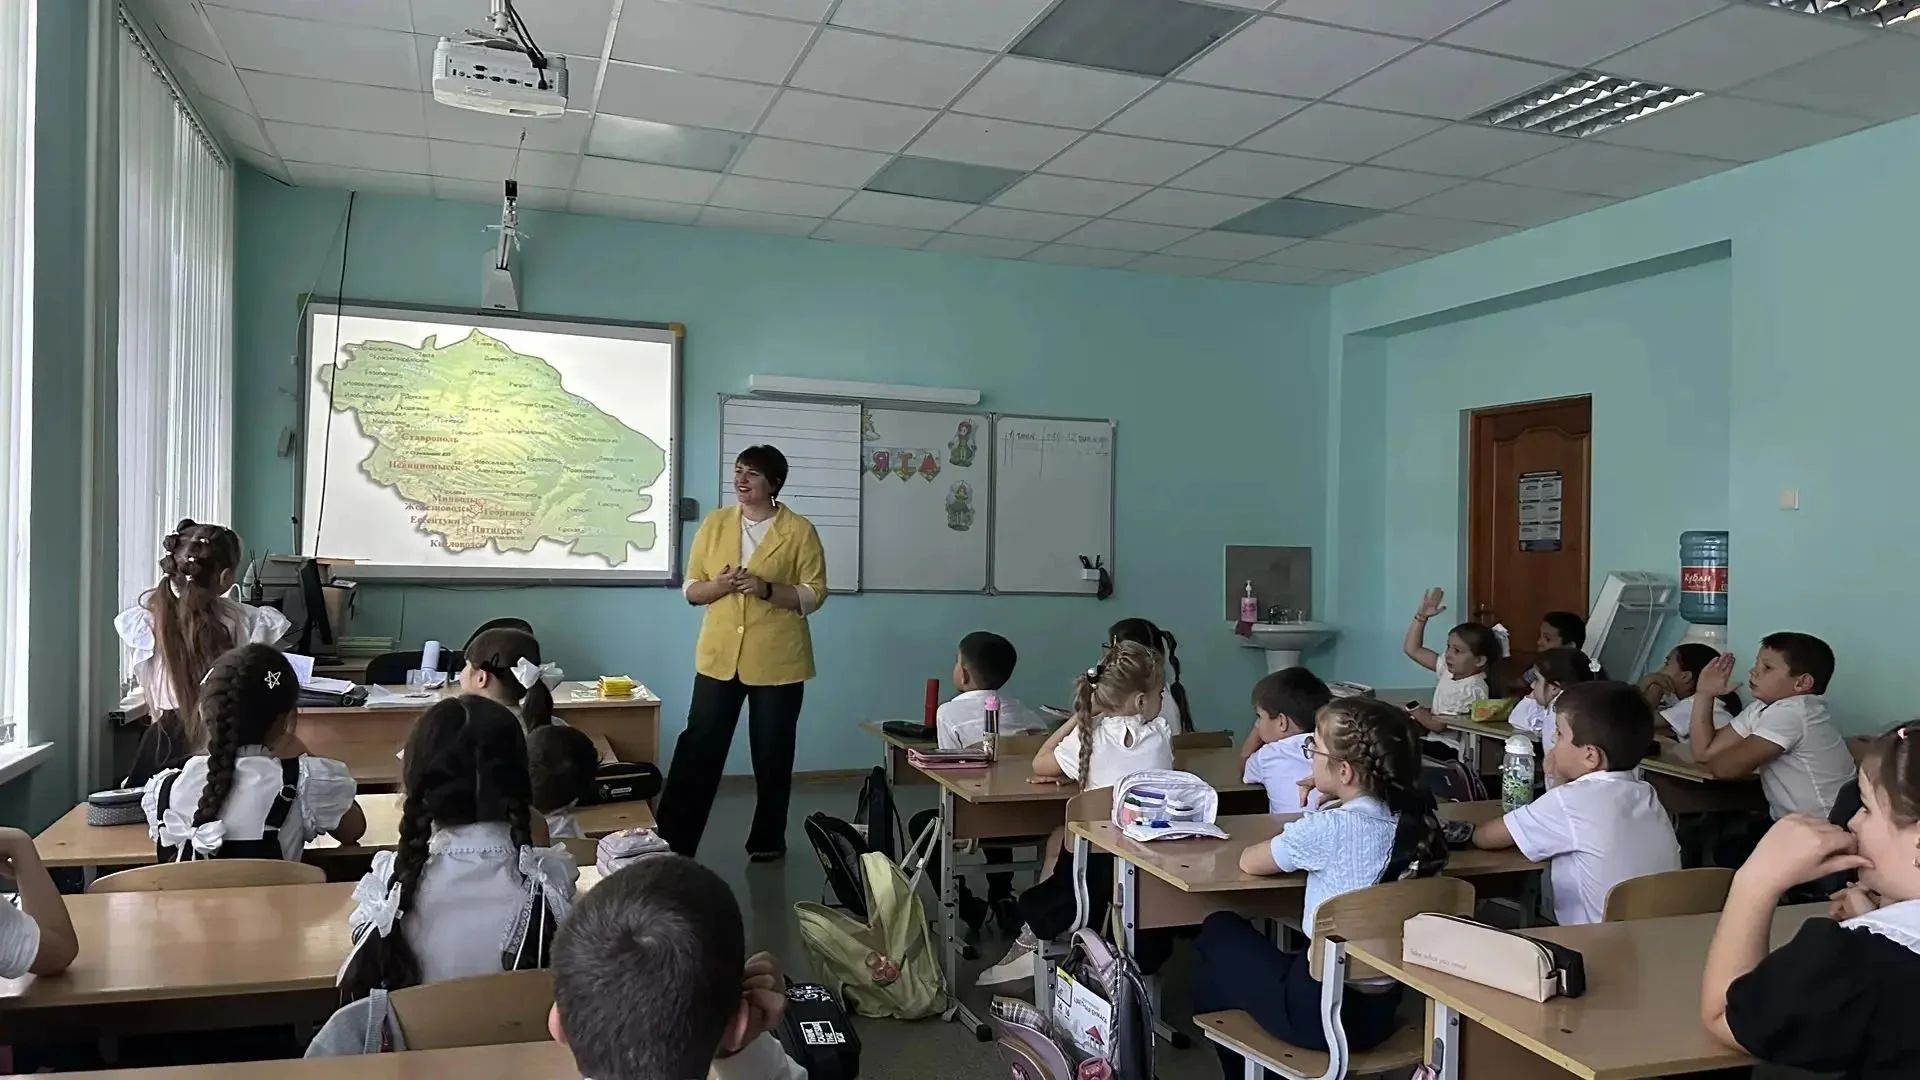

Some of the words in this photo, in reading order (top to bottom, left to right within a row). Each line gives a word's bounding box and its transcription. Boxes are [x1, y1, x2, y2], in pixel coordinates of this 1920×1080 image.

[400, 432, 459, 444] Ставрополь
[389, 460, 461, 471] Невинномысск
[483, 508, 536, 518] Георгиевск
[472, 525, 522, 536] Пятигорск
